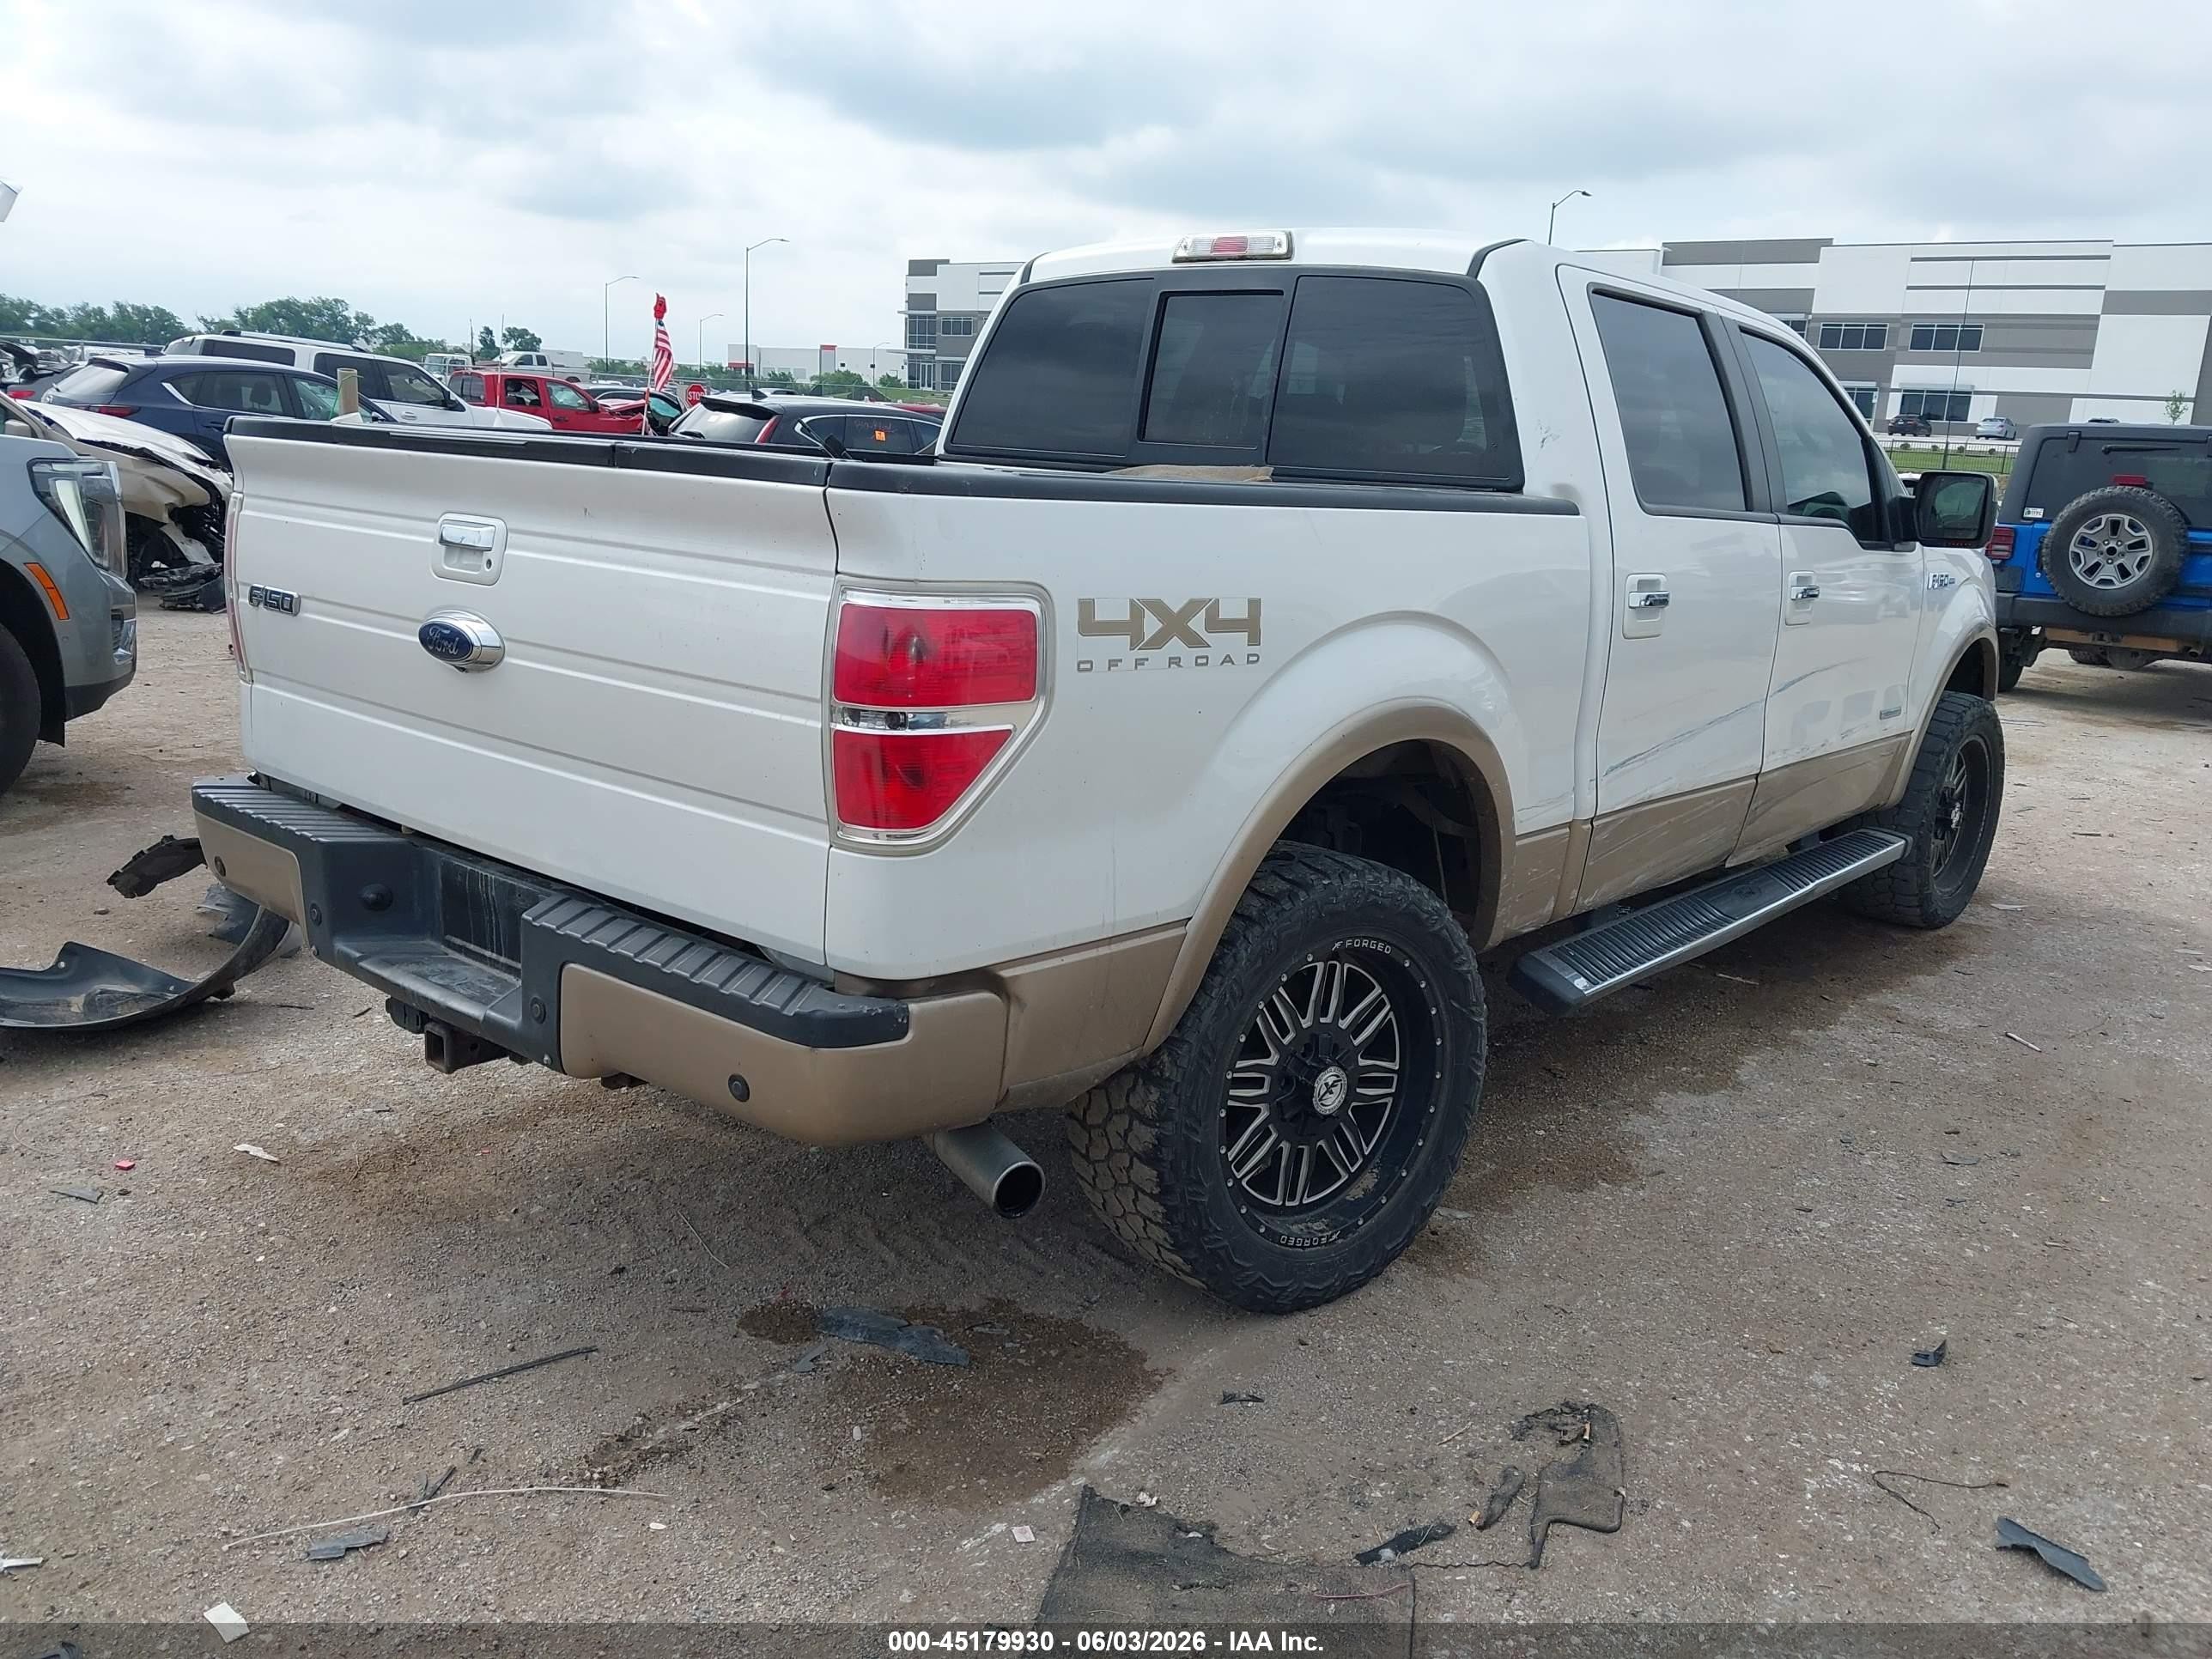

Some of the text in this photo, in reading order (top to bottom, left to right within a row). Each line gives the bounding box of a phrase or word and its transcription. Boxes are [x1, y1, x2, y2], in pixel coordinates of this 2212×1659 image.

[427, 625, 460, 655] Ford
[1077, 653, 1261, 672] OFF ROAD
[1345, 939, 1392, 954] FORGED
[1279, 1235, 1328, 1247] FORGED
